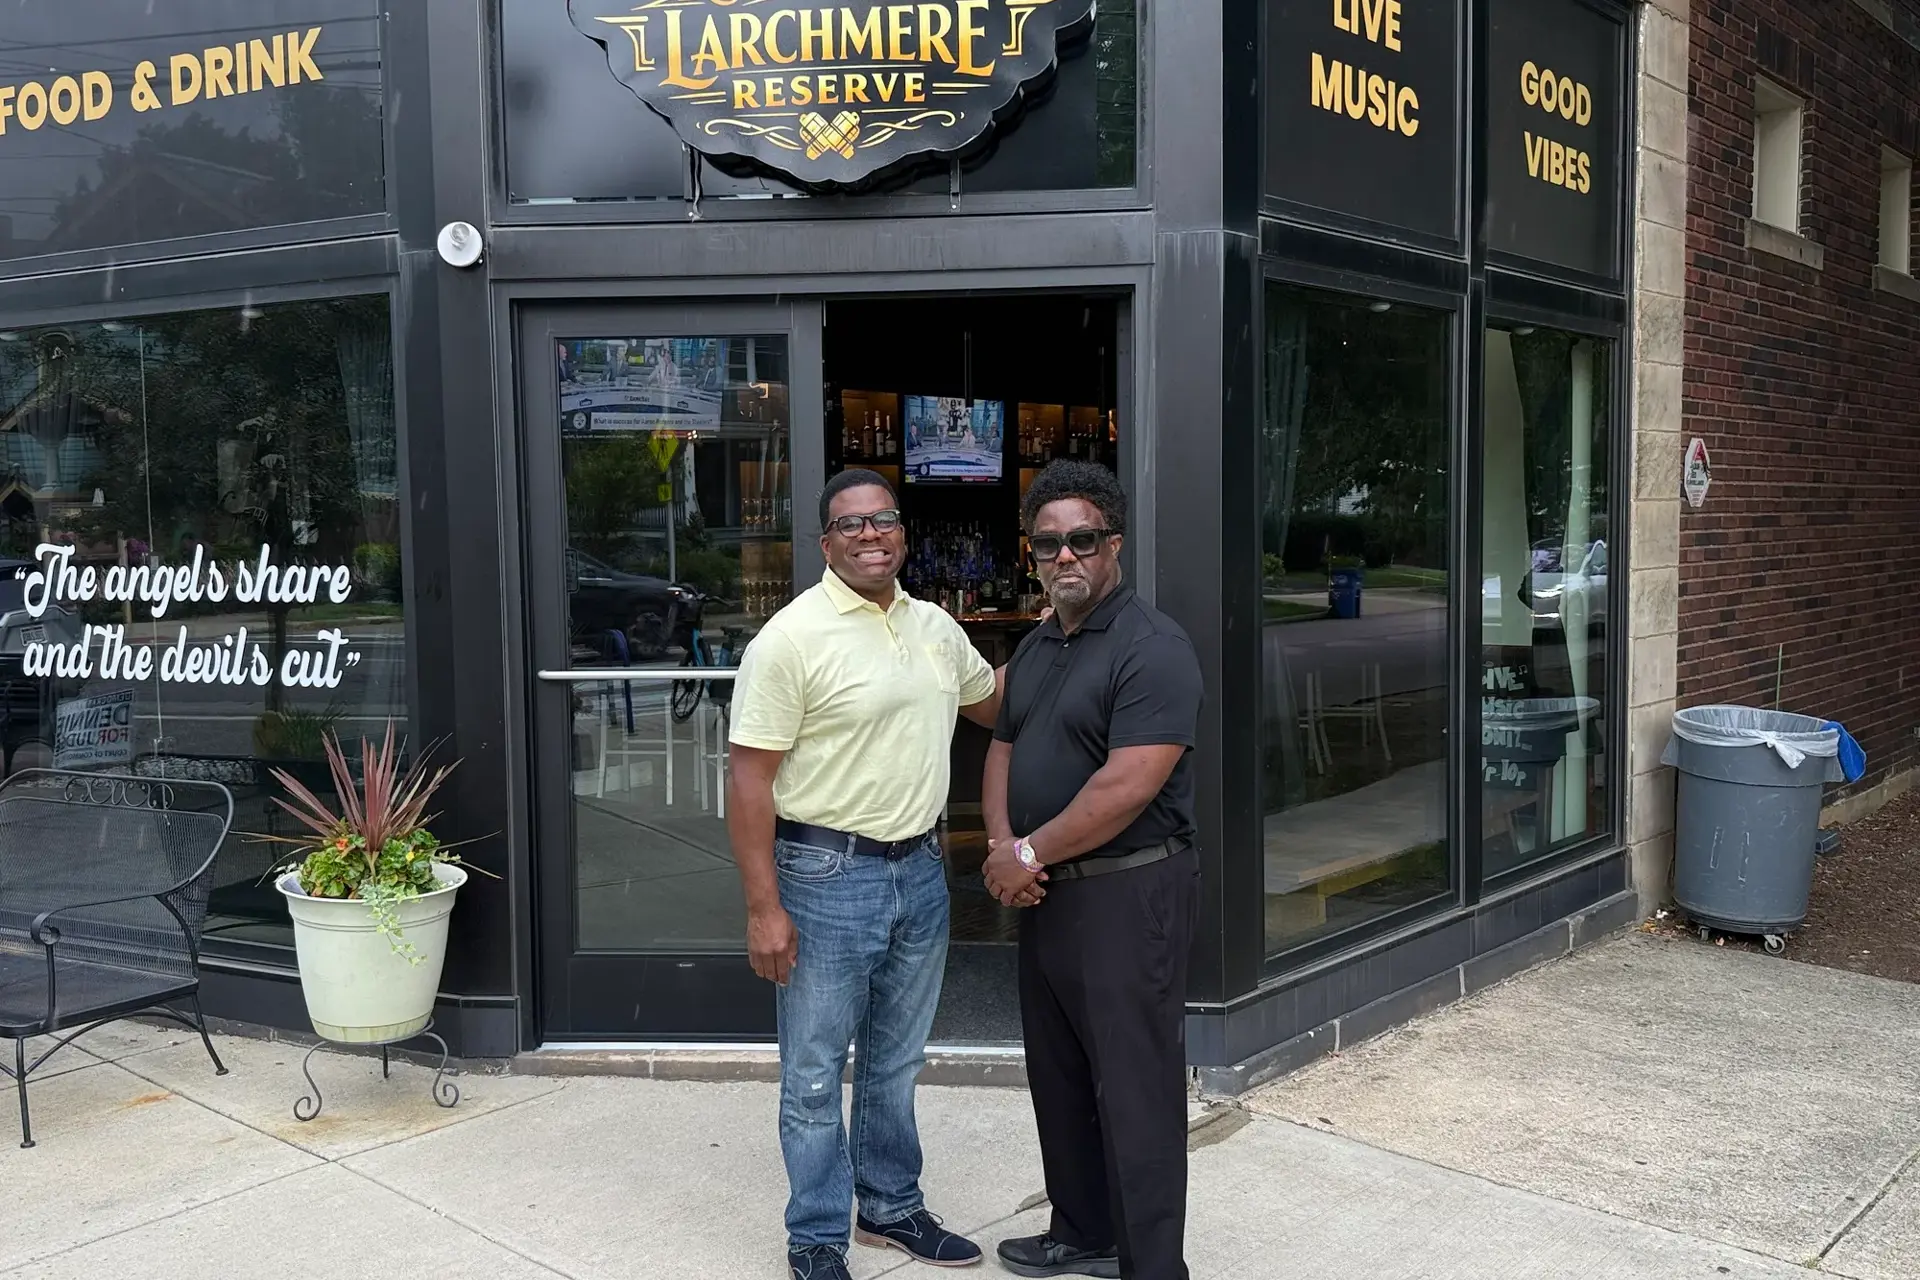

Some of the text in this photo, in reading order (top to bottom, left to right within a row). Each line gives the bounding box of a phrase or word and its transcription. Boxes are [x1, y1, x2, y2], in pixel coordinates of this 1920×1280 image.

[657, 1, 996, 91] LARCHMERE
[1333, 0, 1402, 53] LIVE
[0, 26, 324, 136] FOOD & DRINK
[731, 72, 927, 111] RESERVE
[1310, 51, 1420, 138] MUSIC
[1520, 60, 1593, 127] GOOD
[1524, 132, 1592, 194] VIBES
[235, 543, 352, 603] share
[23, 624, 94, 679] and
[93, 624, 154, 681] the
[1482, 666, 1524, 691] IVE
